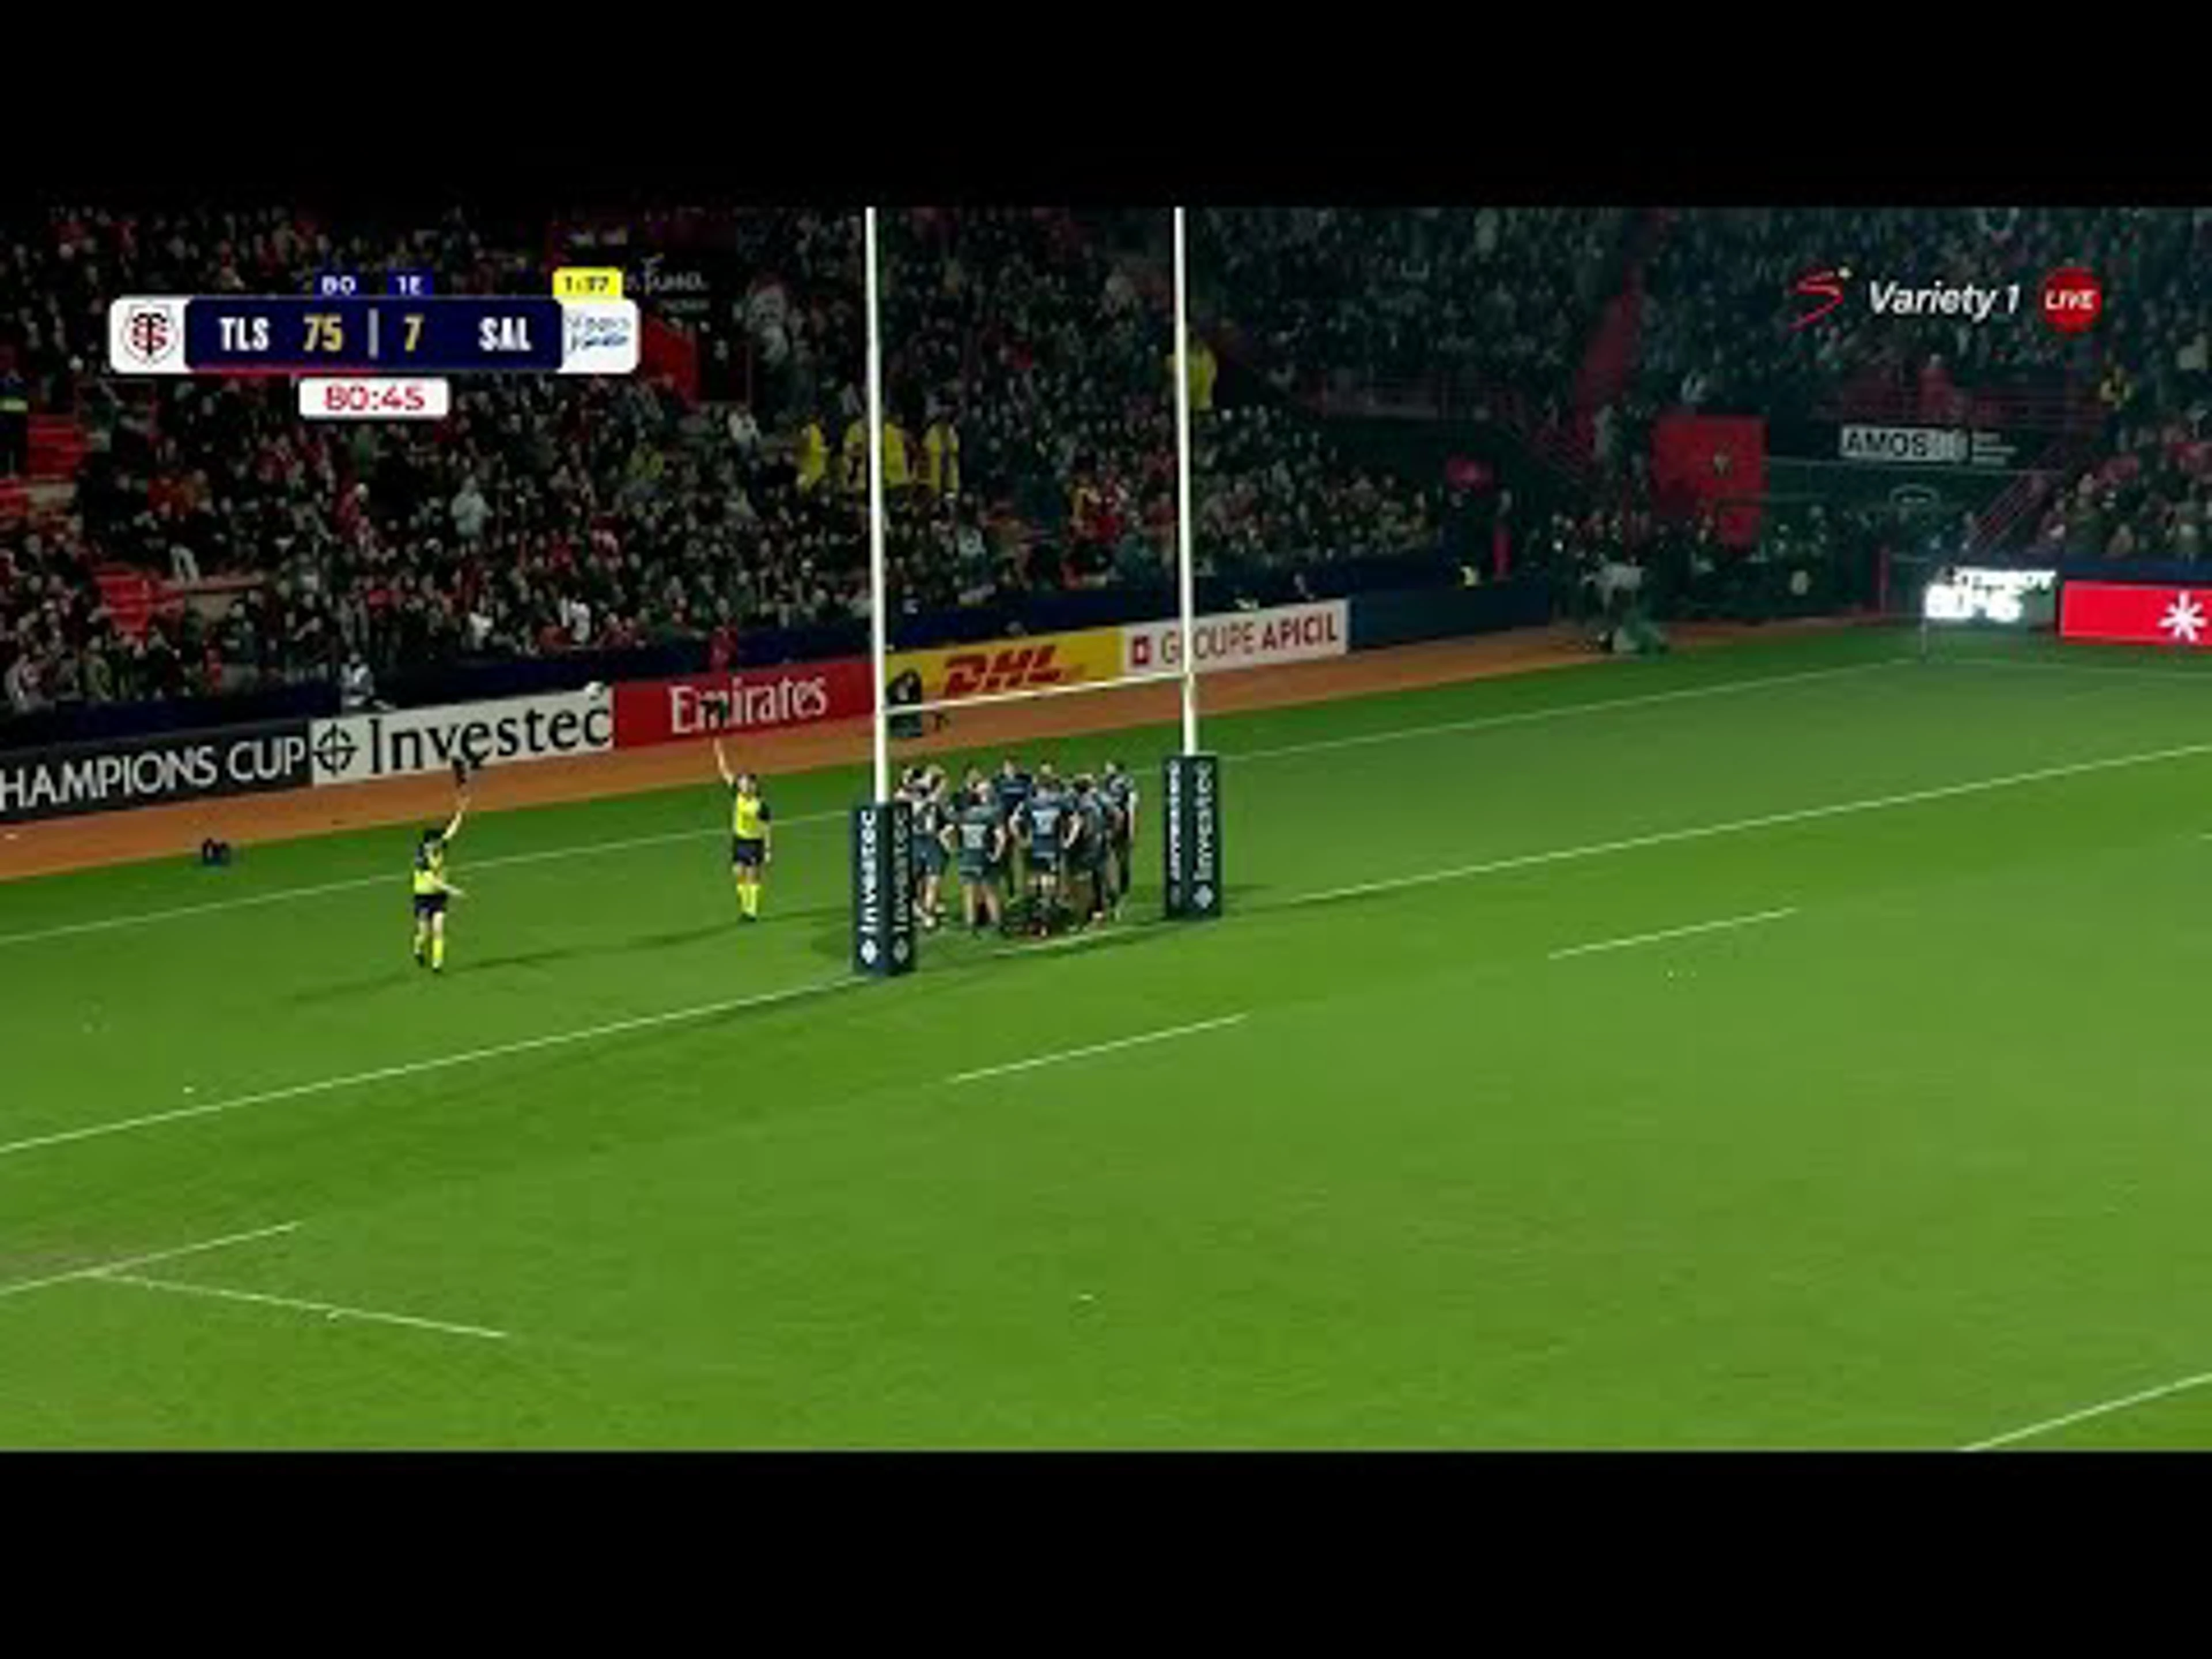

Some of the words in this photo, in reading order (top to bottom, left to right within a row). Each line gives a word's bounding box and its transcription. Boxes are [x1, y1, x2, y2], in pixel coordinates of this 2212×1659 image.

[1161, 622, 1255, 664] GOUPE
[1261, 612, 1338, 650] APICIL
[944, 644, 1062, 697] DHL
[669, 675, 828, 735] Emirates
[229, 736, 306, 782] CUP
[369, 706, 611, 774] Investec
